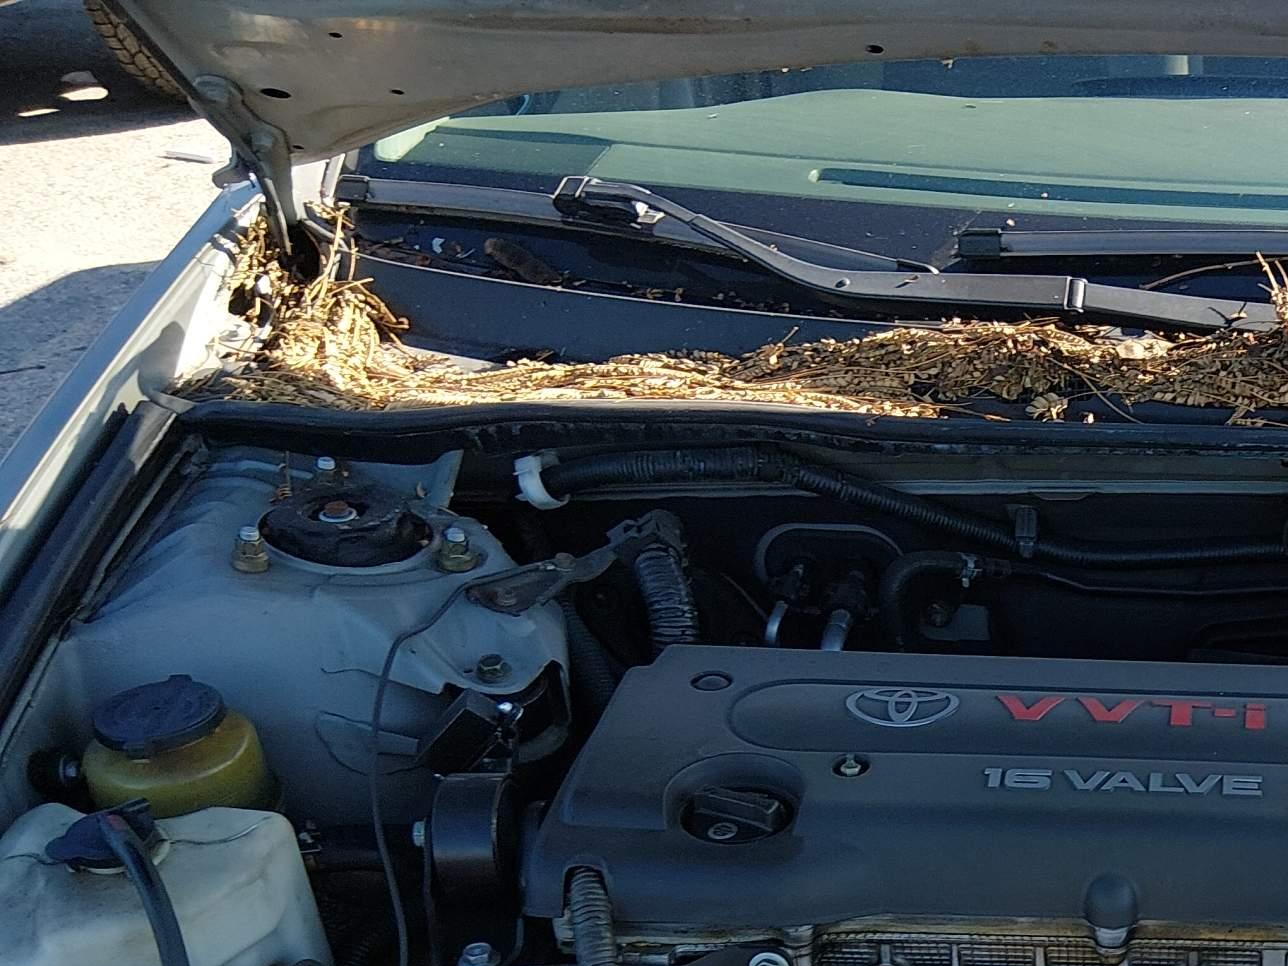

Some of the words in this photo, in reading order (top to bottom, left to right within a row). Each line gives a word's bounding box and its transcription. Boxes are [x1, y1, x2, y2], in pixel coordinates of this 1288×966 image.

[997, 695, 1266, 730] VVT-i
[984, 767, 1052, 790] 16
[1063, 769, 1263, 797] VALVE
